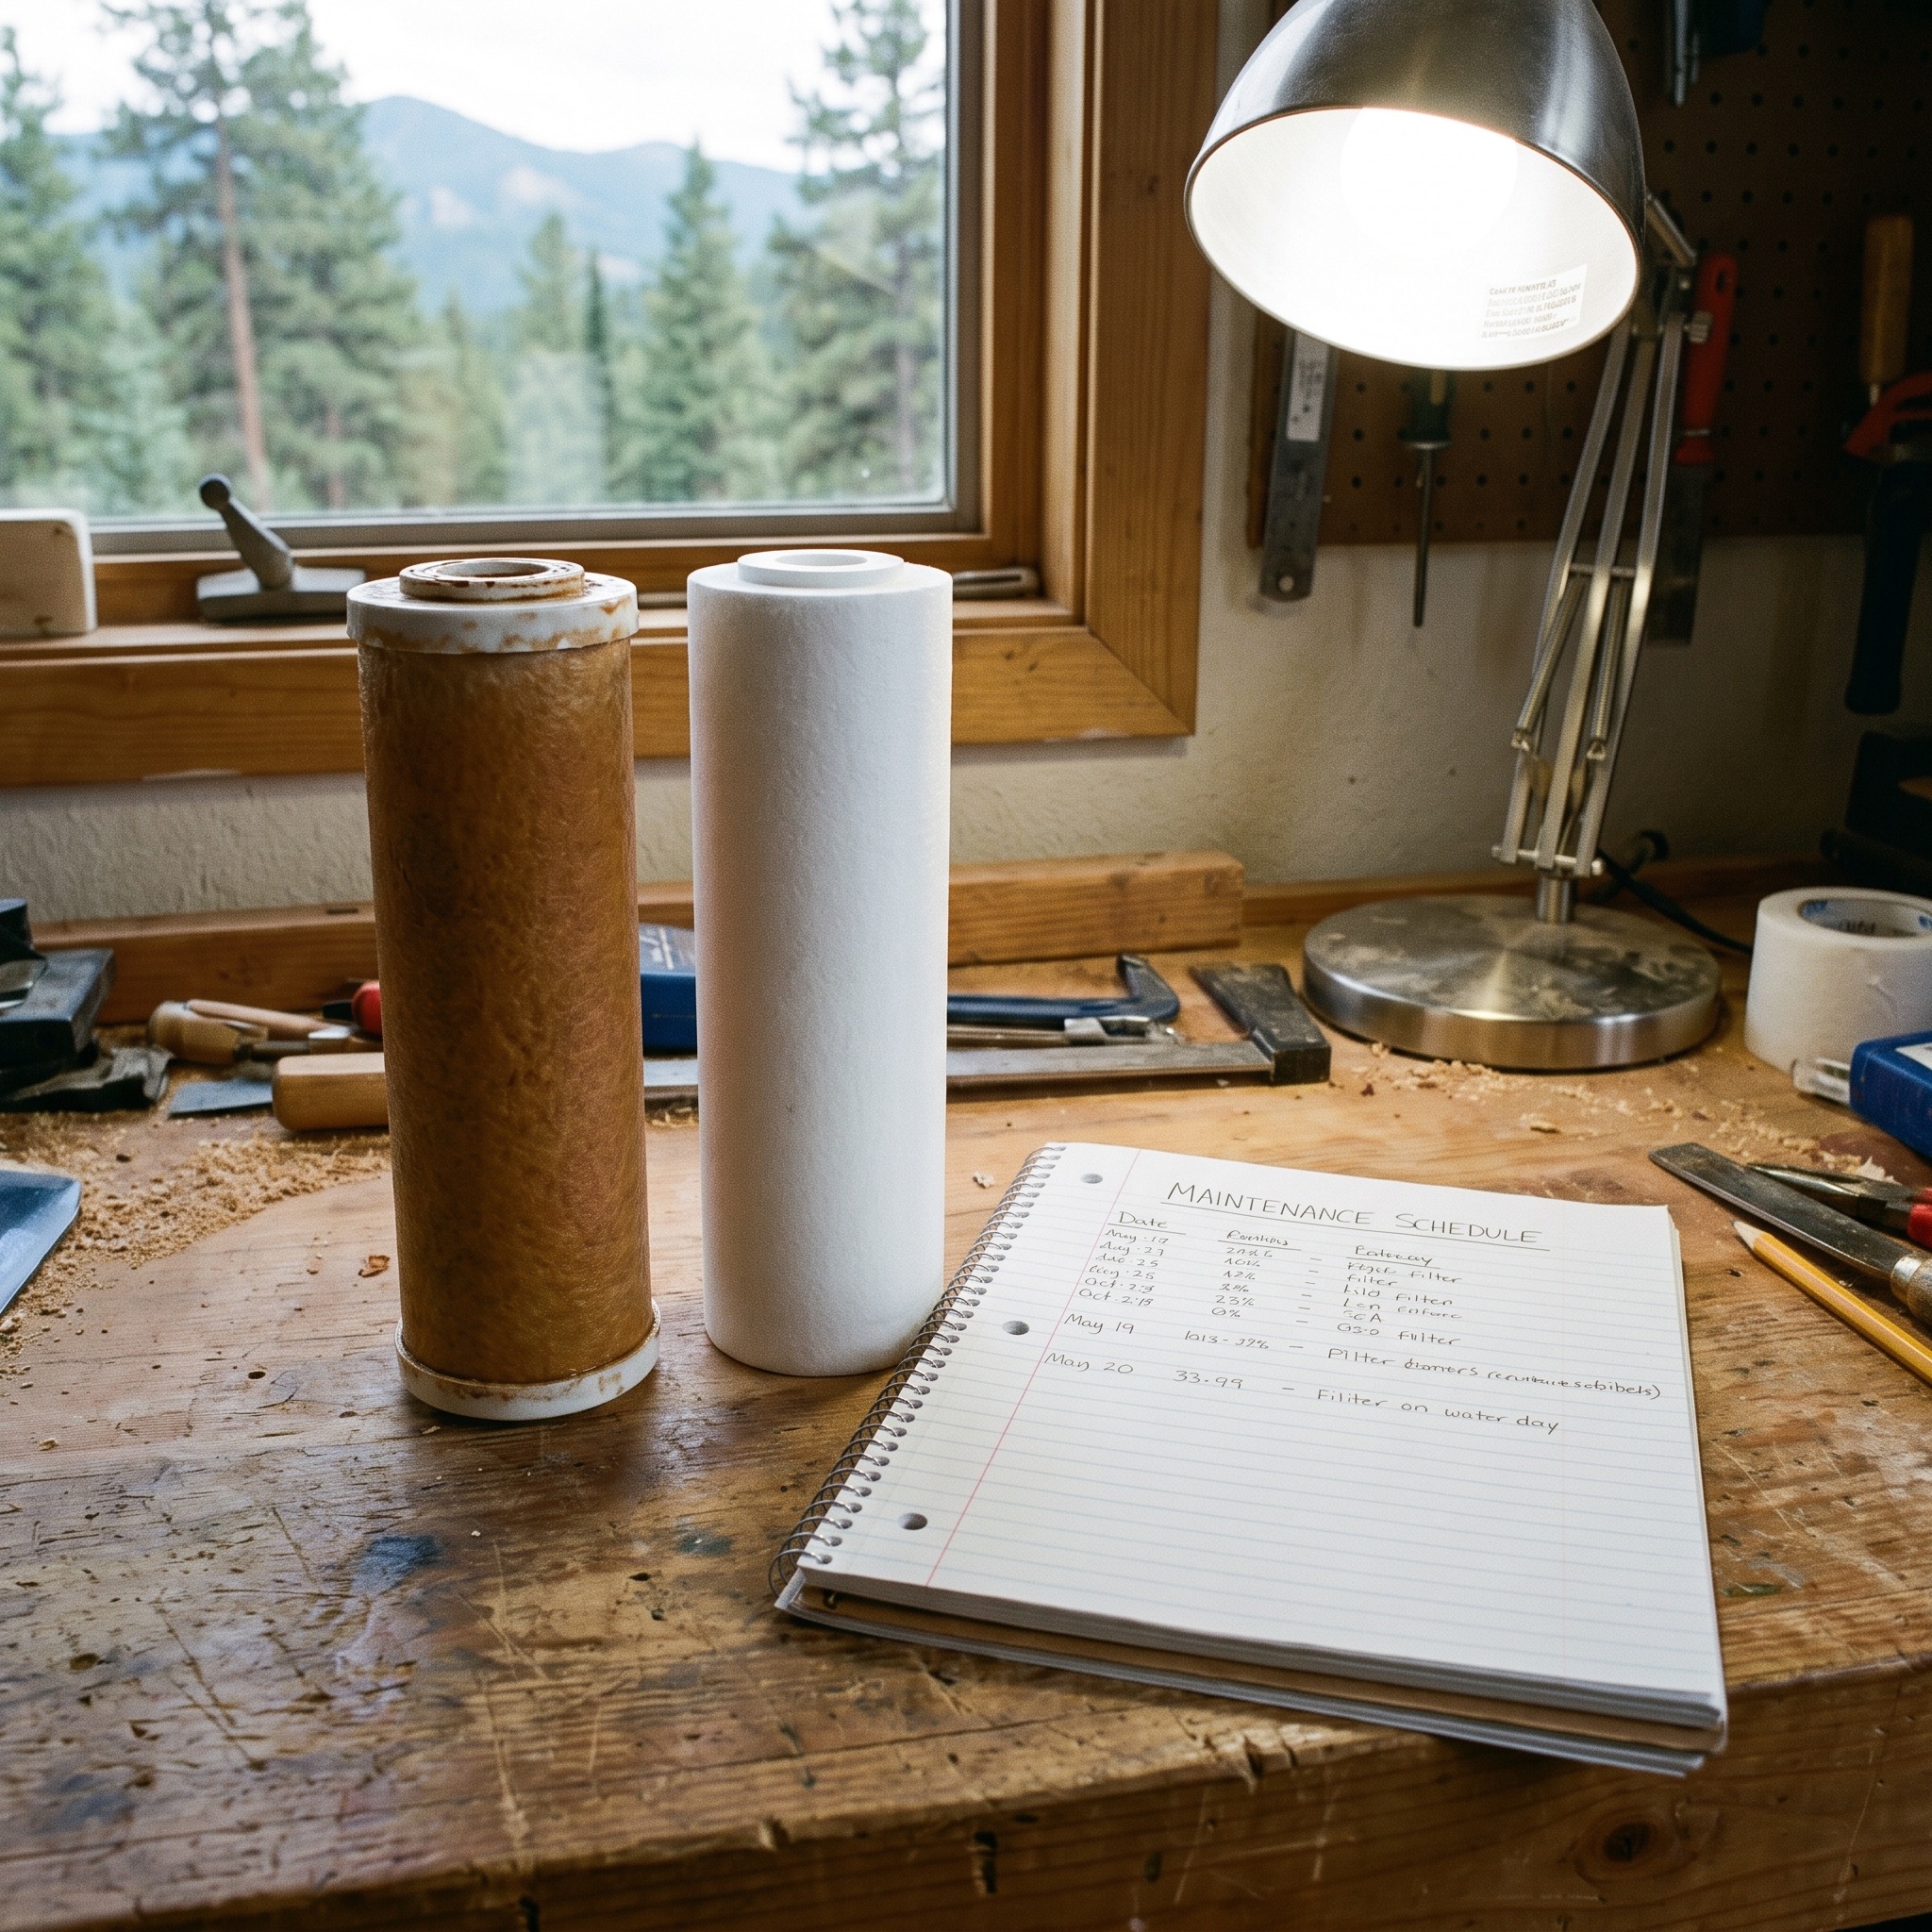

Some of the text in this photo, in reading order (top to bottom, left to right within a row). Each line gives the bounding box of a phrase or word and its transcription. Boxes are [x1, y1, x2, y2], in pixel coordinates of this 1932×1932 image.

[1119, 1210, 1168, 1229] Date
[1167, 1181, 1543, 1243] MAINTENANCE SCHEDULE
[1063, 1313, 1105, 1335] May
[1115, 1321, 1136, 1335] 19
[1103, 1361, 1134, 1374] 20
[1173, 1370, 1243, 1390] 33.99
[1401, 1403, 1428, 1412] on
[1444, 1408, 1508, 1423] water
[1516, 1415, 1559, 1436] day
